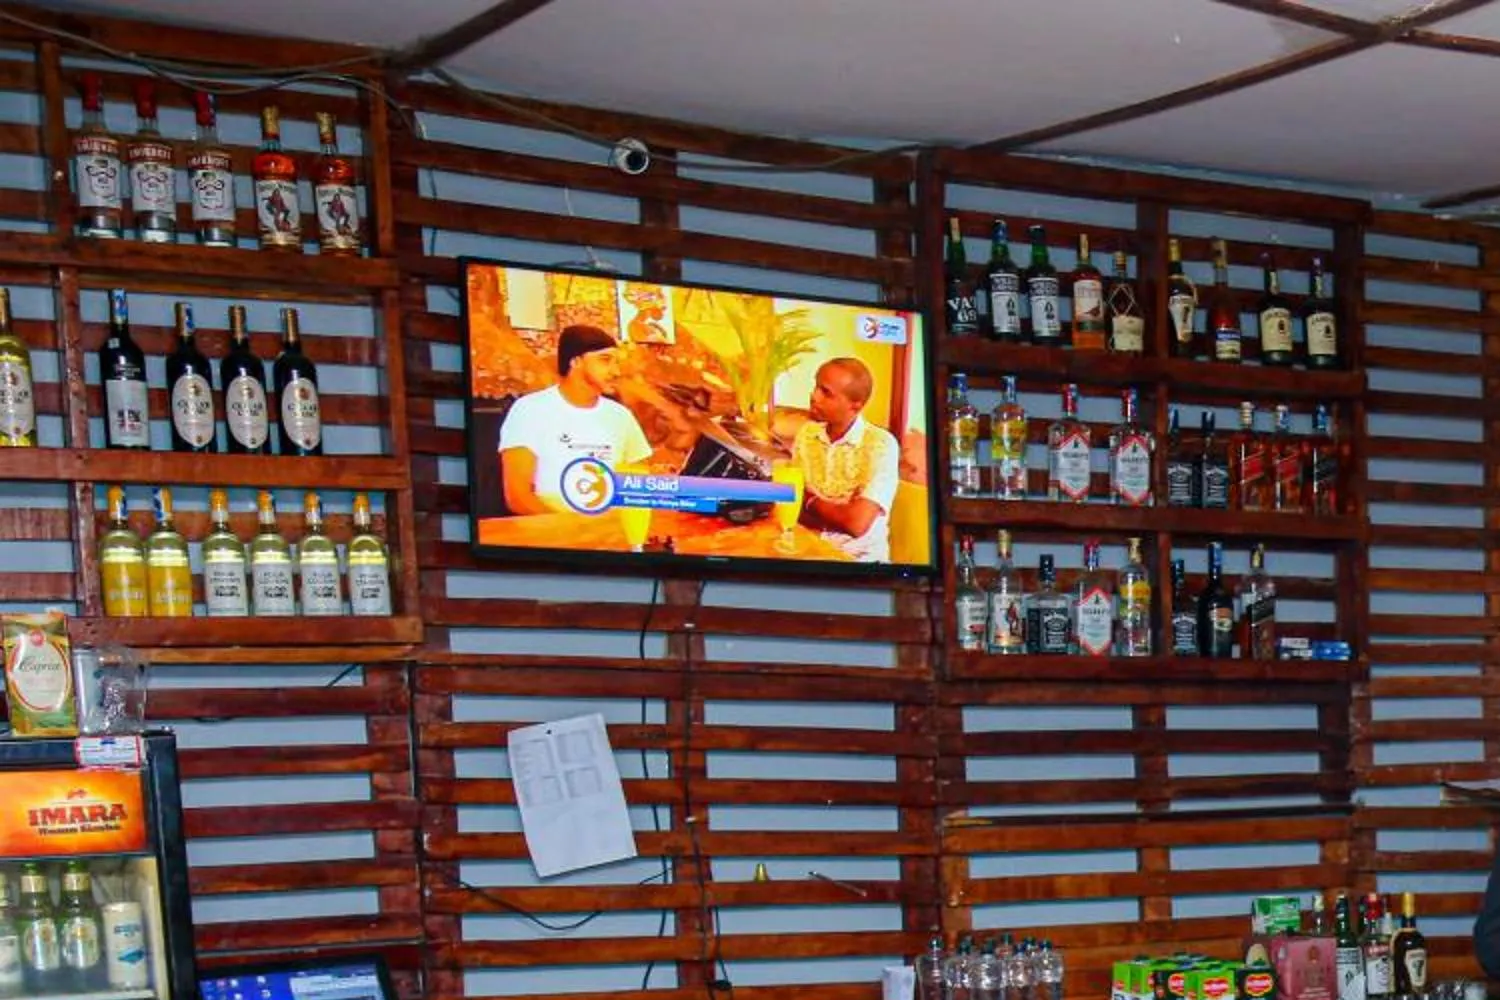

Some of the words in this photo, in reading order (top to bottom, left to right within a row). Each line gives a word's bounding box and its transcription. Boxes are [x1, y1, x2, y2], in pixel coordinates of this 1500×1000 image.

[623, 475, 643, 490] Ali
[645, 476, 680, 491] Said
[28, 803, 129, 827] IMARA
